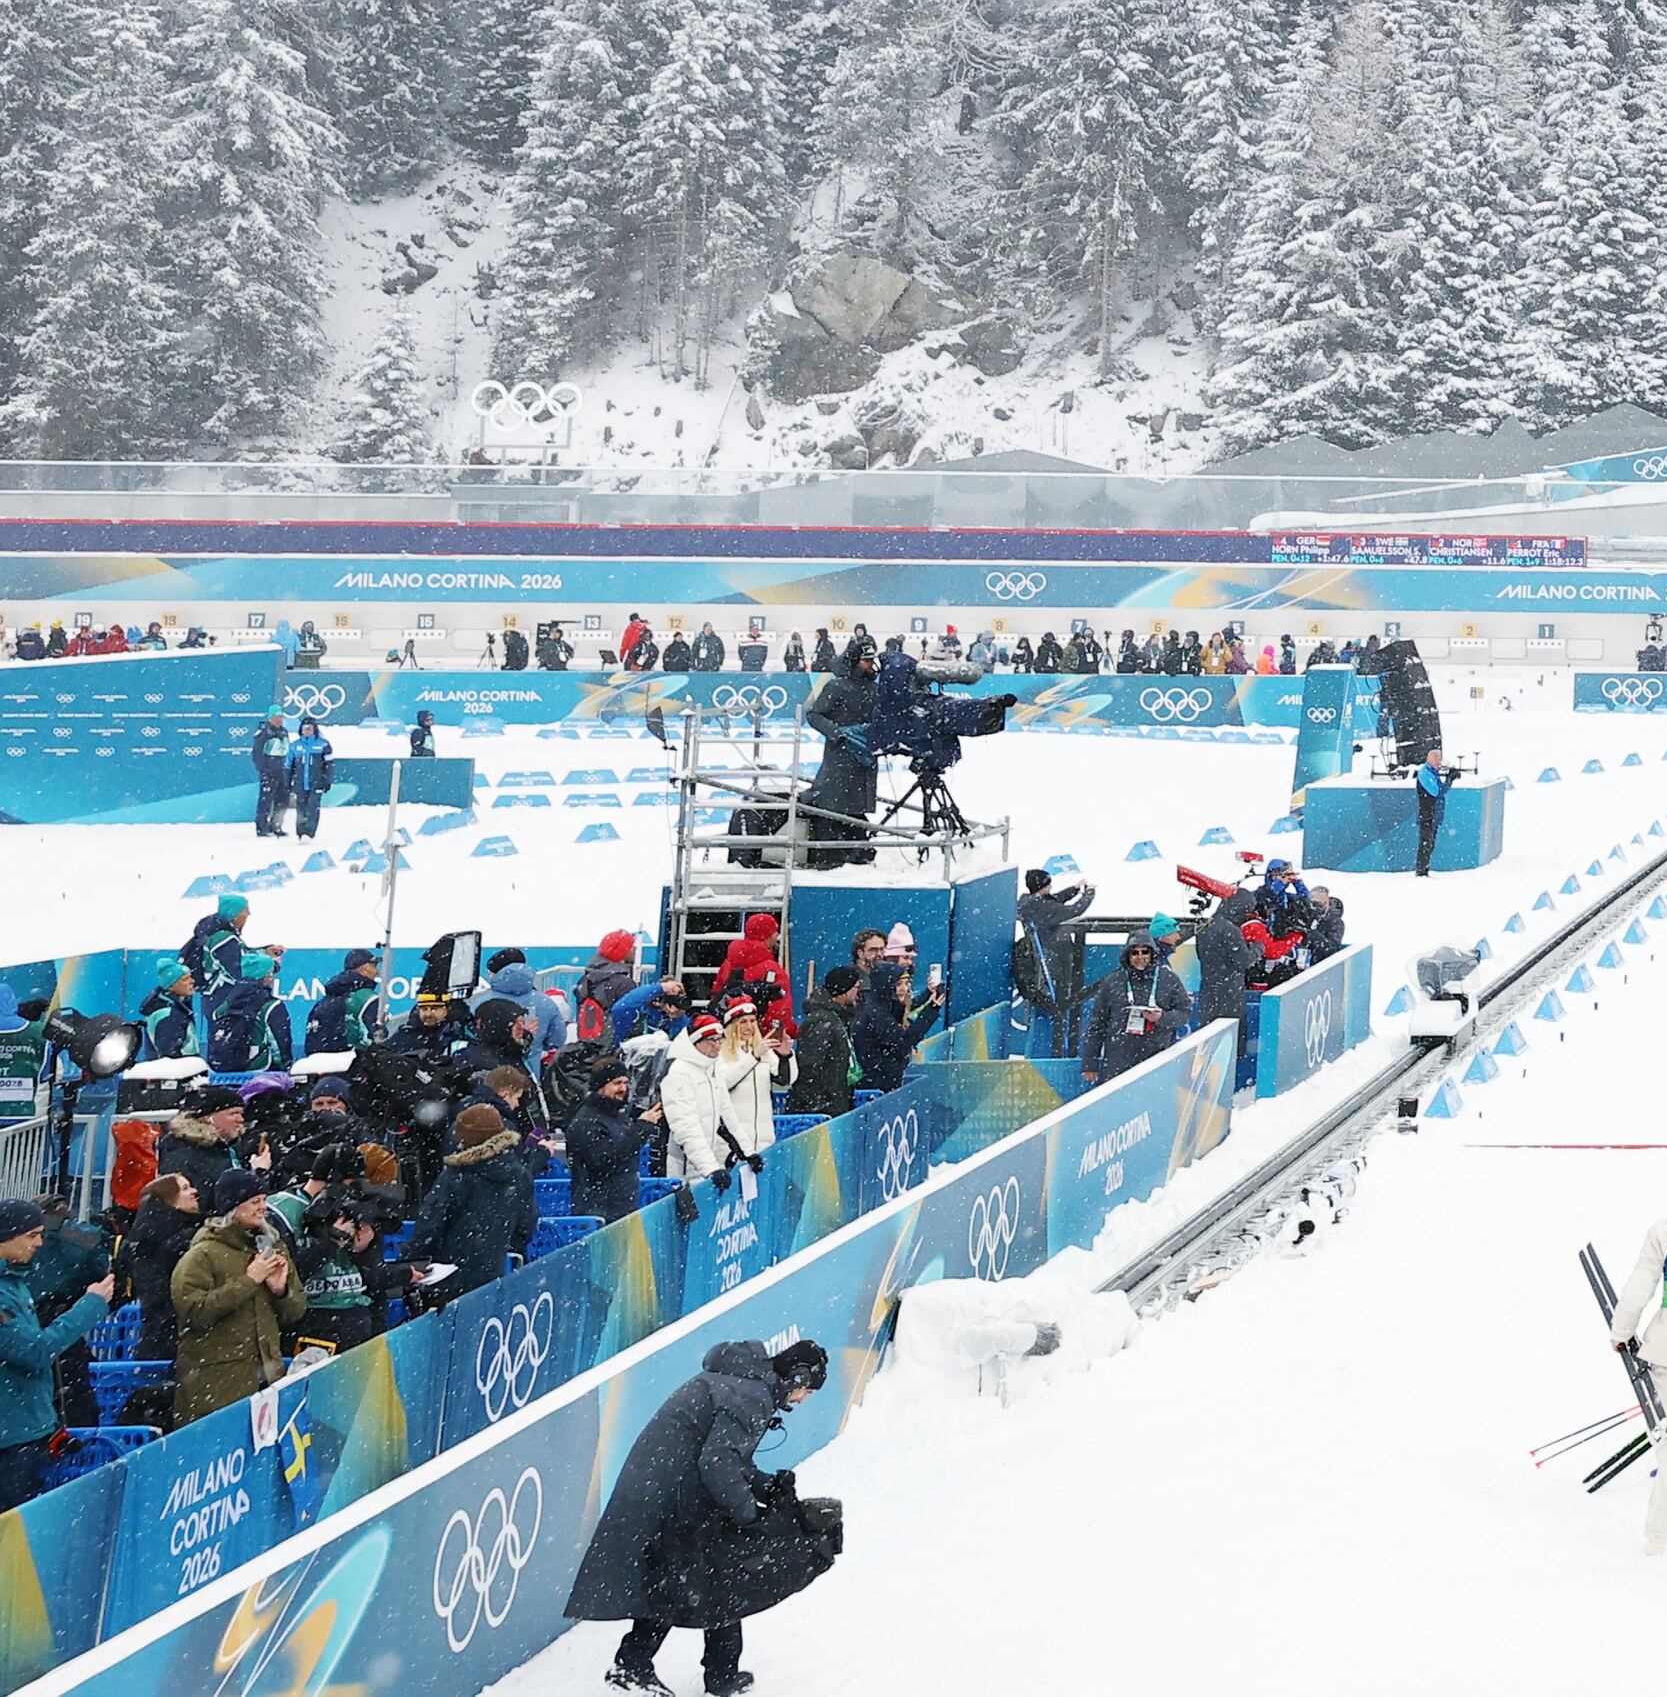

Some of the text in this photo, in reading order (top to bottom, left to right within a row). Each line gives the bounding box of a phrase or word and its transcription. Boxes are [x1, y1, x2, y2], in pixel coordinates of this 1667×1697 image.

[1296, 537, 1316, 545] GER
[1375, 537, 1394, 545] SWE
[1452, 539, 1472, 547] NOR
[1532, 540, 1549, 548] FRA
[1272, 545, 1299, 553] HORN
[1351, 546, 1411, 555] SAMUELSSON
[1430, 548, 1493, 557] CHRISTIANSEN
[1507, 548, 1542, 557] PERROT
[334, 572, 562, 590] MILANO CORTINA 2026
[1496, 584, 1576, 600] MILANO
[1580, 584, 1661, 601] CORTINA
[77, 615, 91, 626] 19
[251, 615, 263, 627] 17
[419, 616, 433, 627] 15
[504, 617, 516, 627] 14
[587, 617, 599, 628] 13
[670, 618, 682, 628] 12
[832, 618, 844, 629] 10
[915, 619, 923, 630] 9
[1075, 621, 1083, 632] 7
[1232, 622, 1241, 634] 5
[1310, 624, 1318, 634] 4
[1389, 623, 1397, 635] 3
[1466, 624, 1473, 635] 2
[1543, 625, 1550, 637] 1
[416, 690, 542, 703] MILANO CORTINA
[464, 703, 493, 714] 2026
[1078, 1110, 1152, 1179] MILANO CORTINA
[1105, 1158, 1124, 1196] 2026
[160, 1448, 245, 1520] MILANO
[170, 1488, 250, 1556] CORTINA
[178, 1542, 222, 1595] 2026
